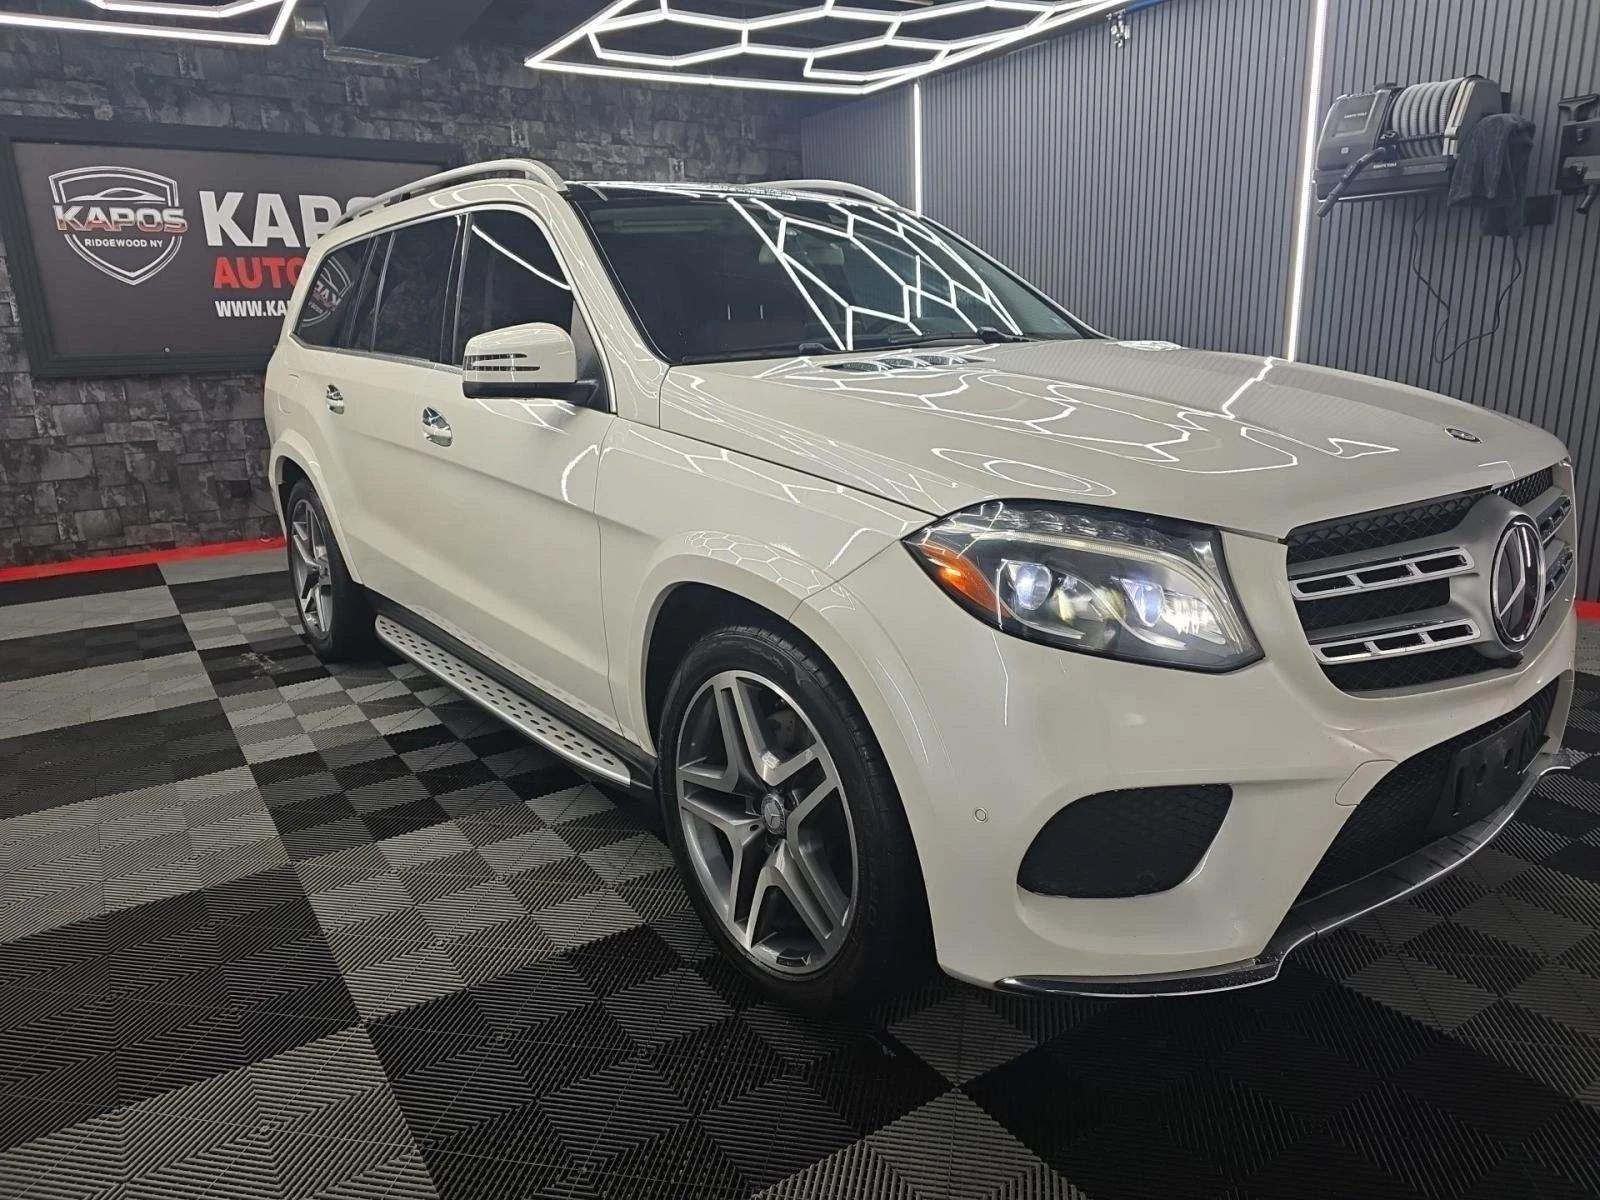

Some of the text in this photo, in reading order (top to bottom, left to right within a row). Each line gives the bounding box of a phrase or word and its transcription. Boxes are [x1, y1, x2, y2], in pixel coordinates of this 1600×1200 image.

[52, 205, 188, 233] KAPOS
[199, 191, 376, 248] KAP
[84, 238, 163, 247] RIDGEWOOD NY
[214, 300, 291, 317] WWW.KA
